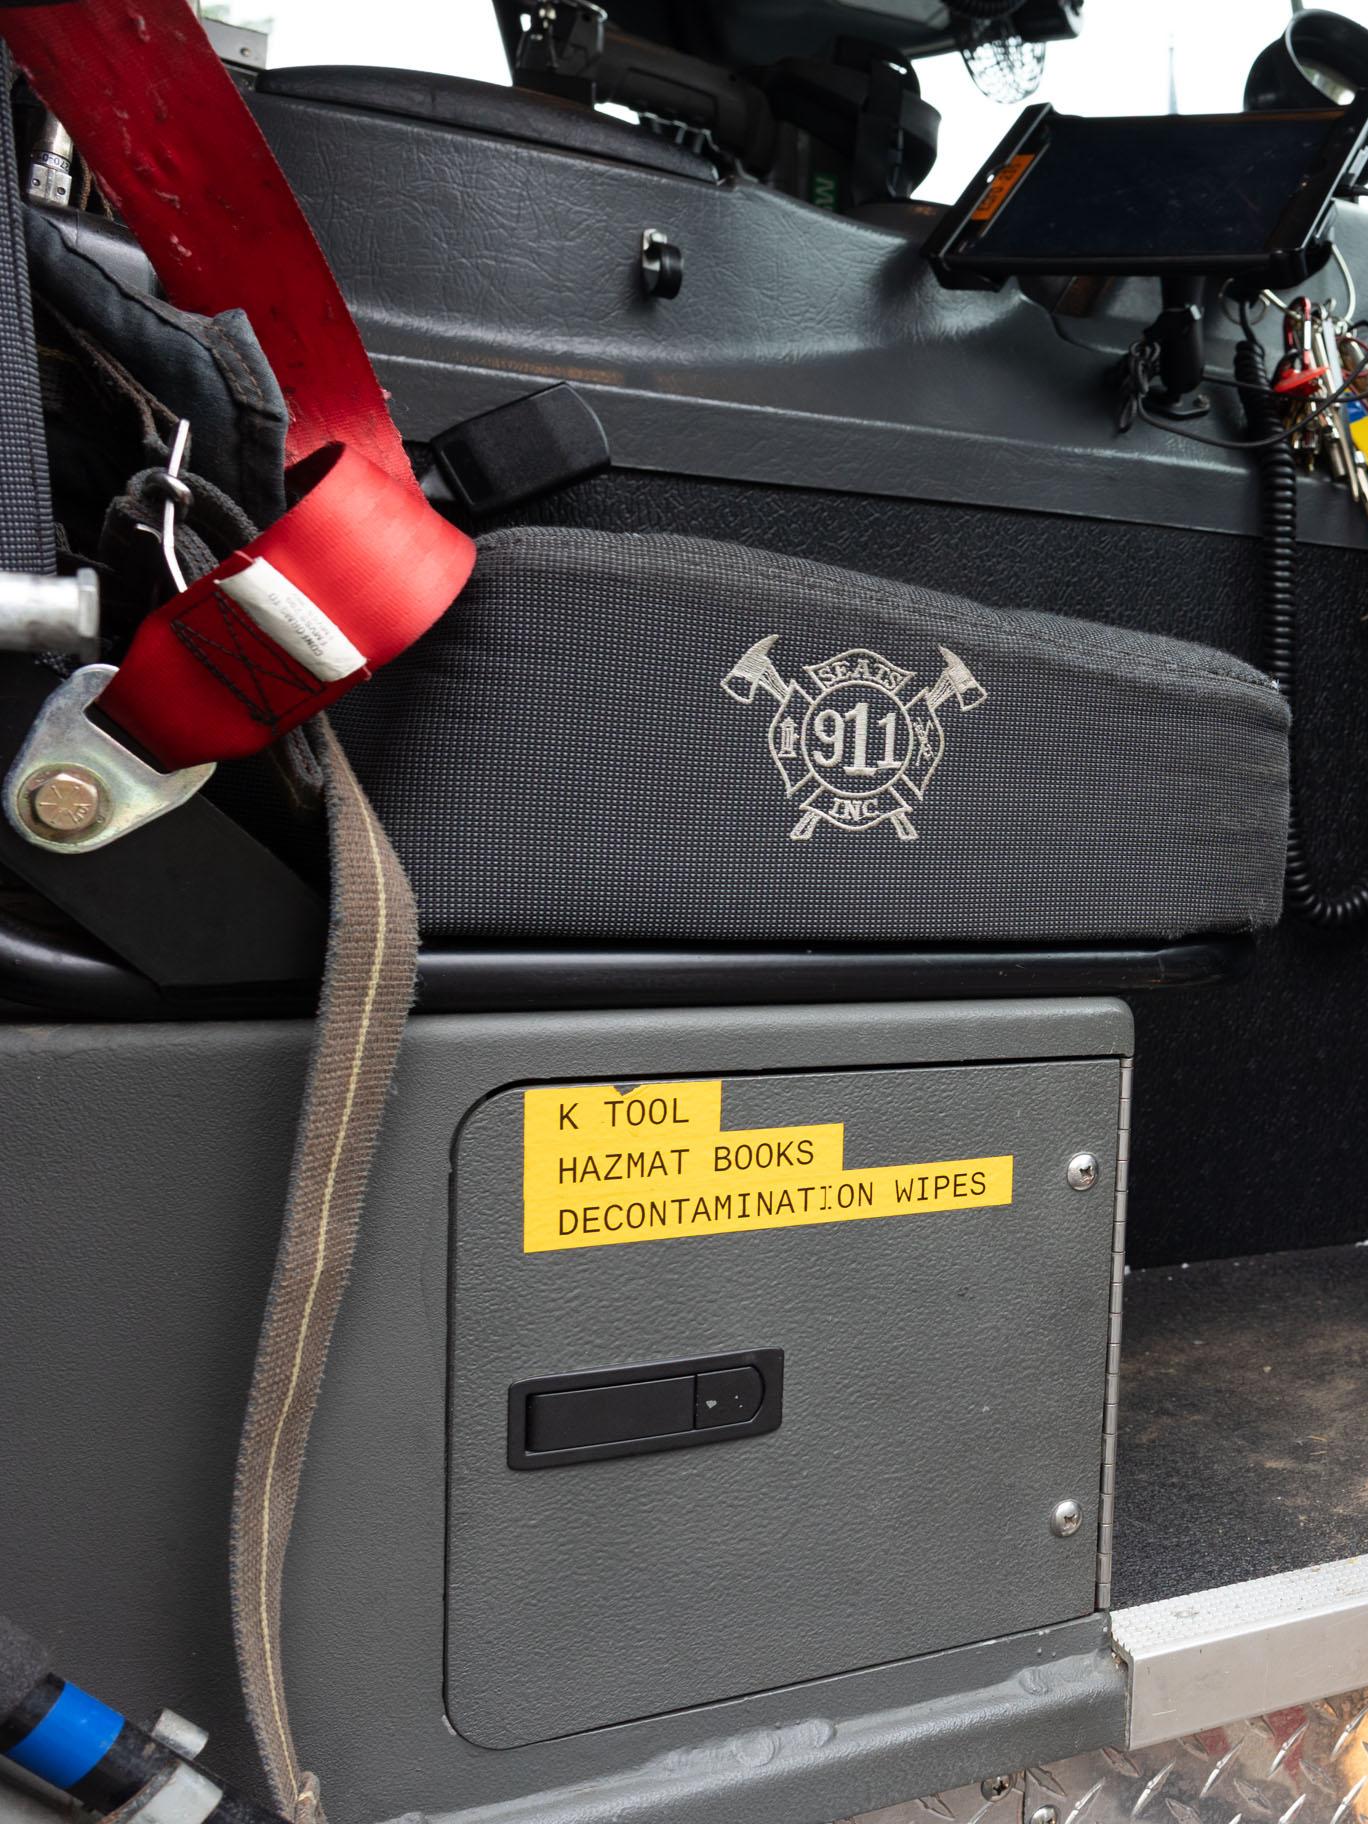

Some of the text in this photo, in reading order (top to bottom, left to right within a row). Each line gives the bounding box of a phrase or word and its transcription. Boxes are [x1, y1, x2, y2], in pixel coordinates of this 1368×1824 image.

[817, 658, 902, 688] SEATS
[814, 702, 901, 776] 911
[830, 798, 879, 820] INC
[558, 1097, 690, 1131] K TOOL
[558, 1139, 815, 1184] HAZMAT BOOKS
[558, 1171, 987, 1236] DECONTAMINATION WIPES
